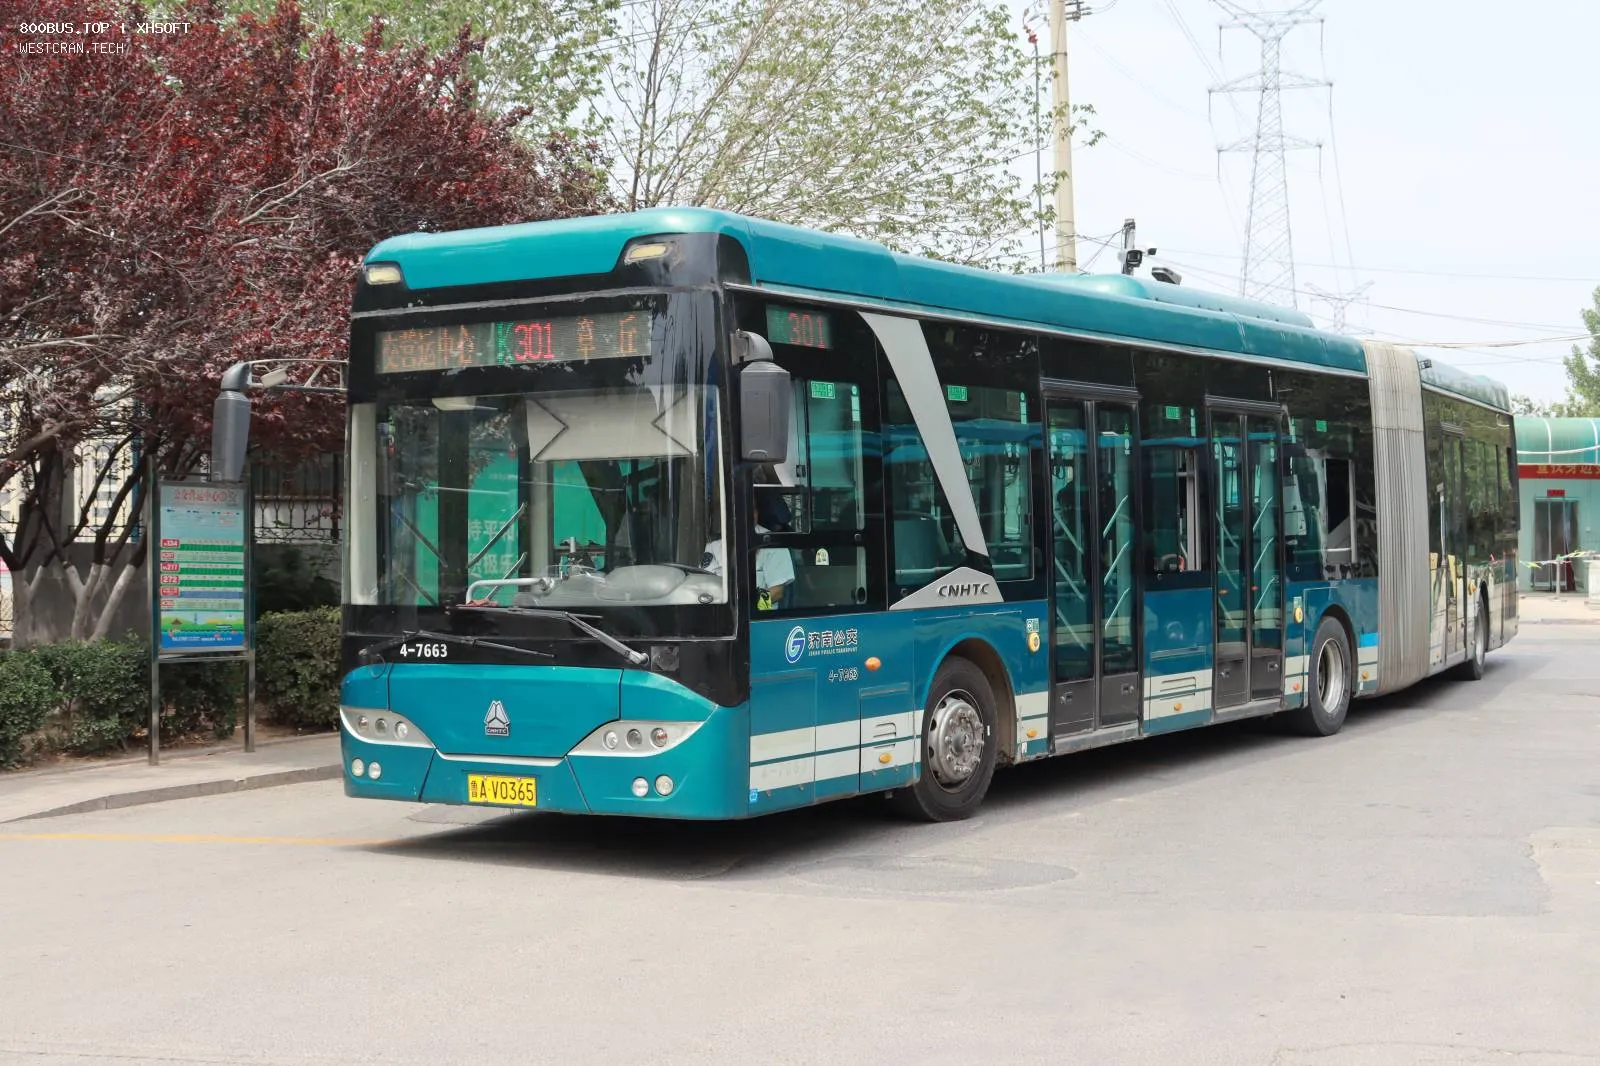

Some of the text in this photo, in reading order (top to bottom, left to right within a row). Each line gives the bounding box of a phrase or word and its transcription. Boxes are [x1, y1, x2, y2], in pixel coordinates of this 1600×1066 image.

[938, 583, 991, 598] CNHTC
[808, 628, 858, 650] 济南公交
[399, 643, 448, 658] 4-7663
